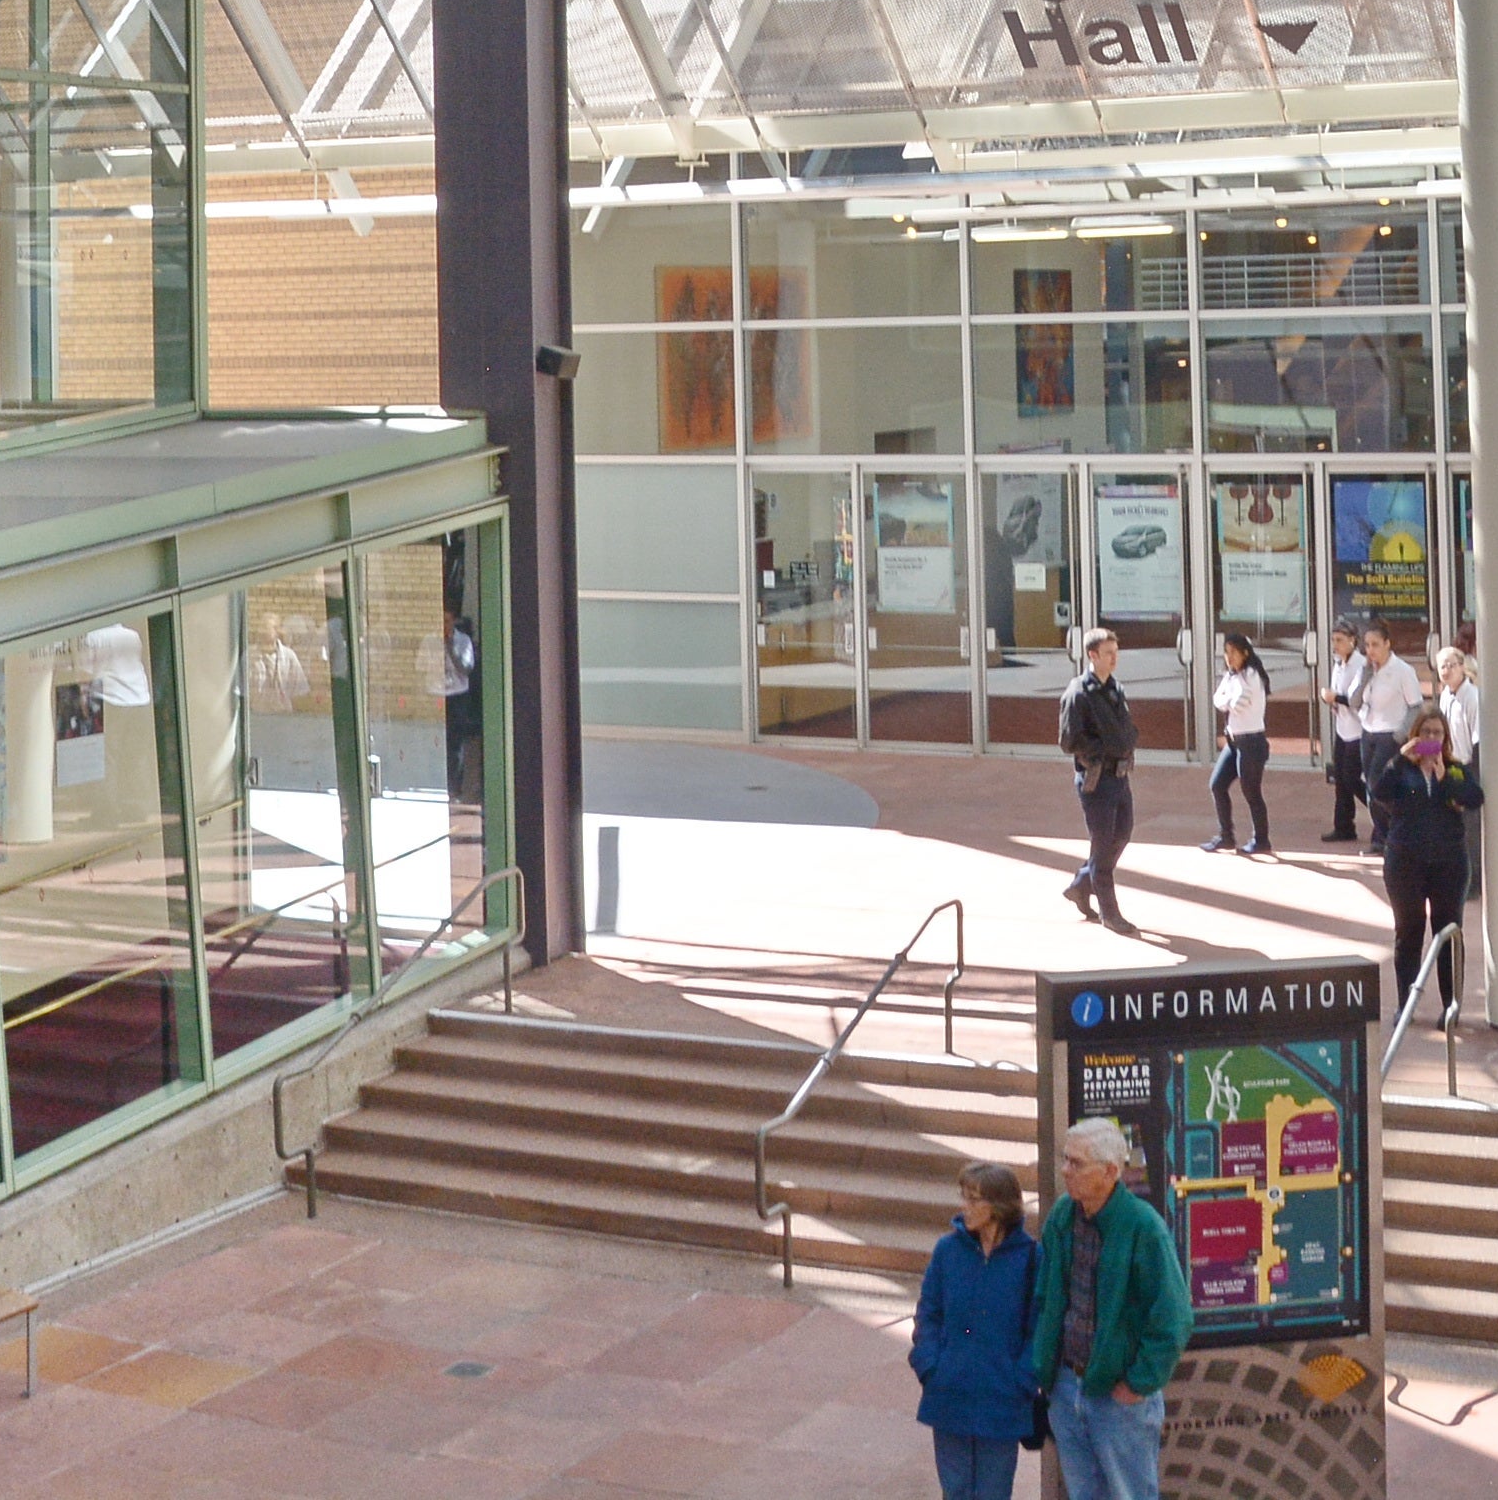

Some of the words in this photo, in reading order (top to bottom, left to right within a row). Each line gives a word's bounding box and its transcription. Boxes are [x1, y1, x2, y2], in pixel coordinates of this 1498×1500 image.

[1003, 3, 1197, 69] Hall
[1346, 573, 1364, 584] The
[1366, 573, 1385, 584] Soft
[1387, 573, 1425, 585] Bulletin
[1109, 980, 1365, 1022] INFORMATION
[1084, 1052, 1136, 1066] Welcome
[1084, 1065, 1150, 1081] DENVER
[1084, 1078, 1150, 1091] PERFORMING
